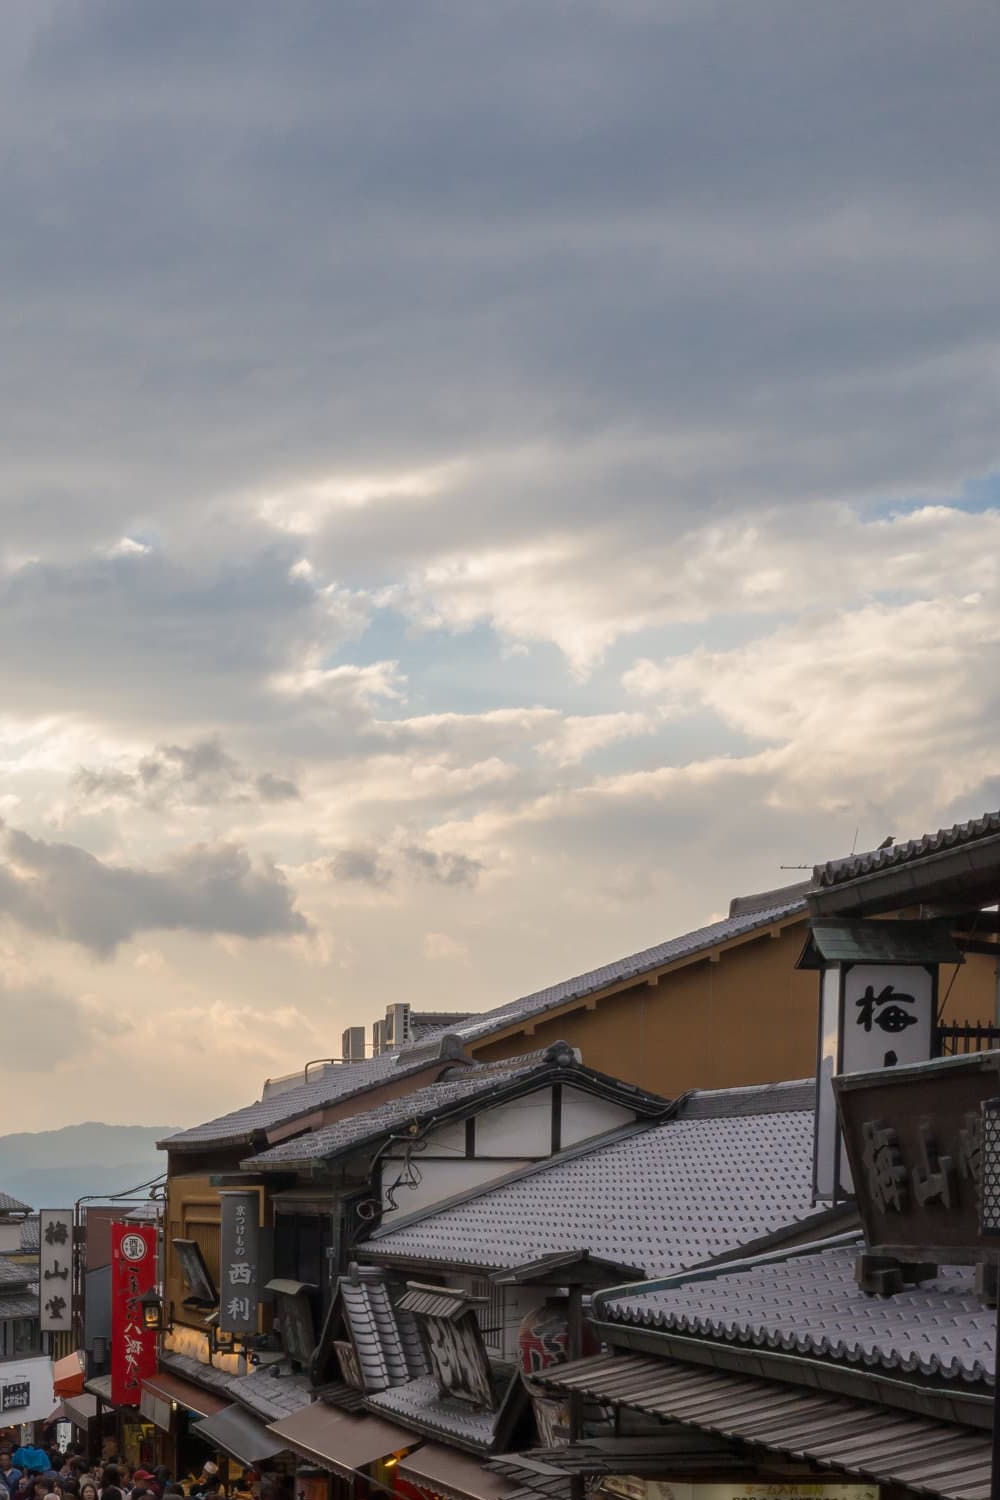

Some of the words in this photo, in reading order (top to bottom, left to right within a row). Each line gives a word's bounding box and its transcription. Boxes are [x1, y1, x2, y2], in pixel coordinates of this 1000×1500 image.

[856, 985, 918, 1066] 梅
[235, 1205, 246, 1256] 京つけもの
[44, 1220, 69, 1320] 梅山堂
[227, 1262, 252, 1321] 西利
